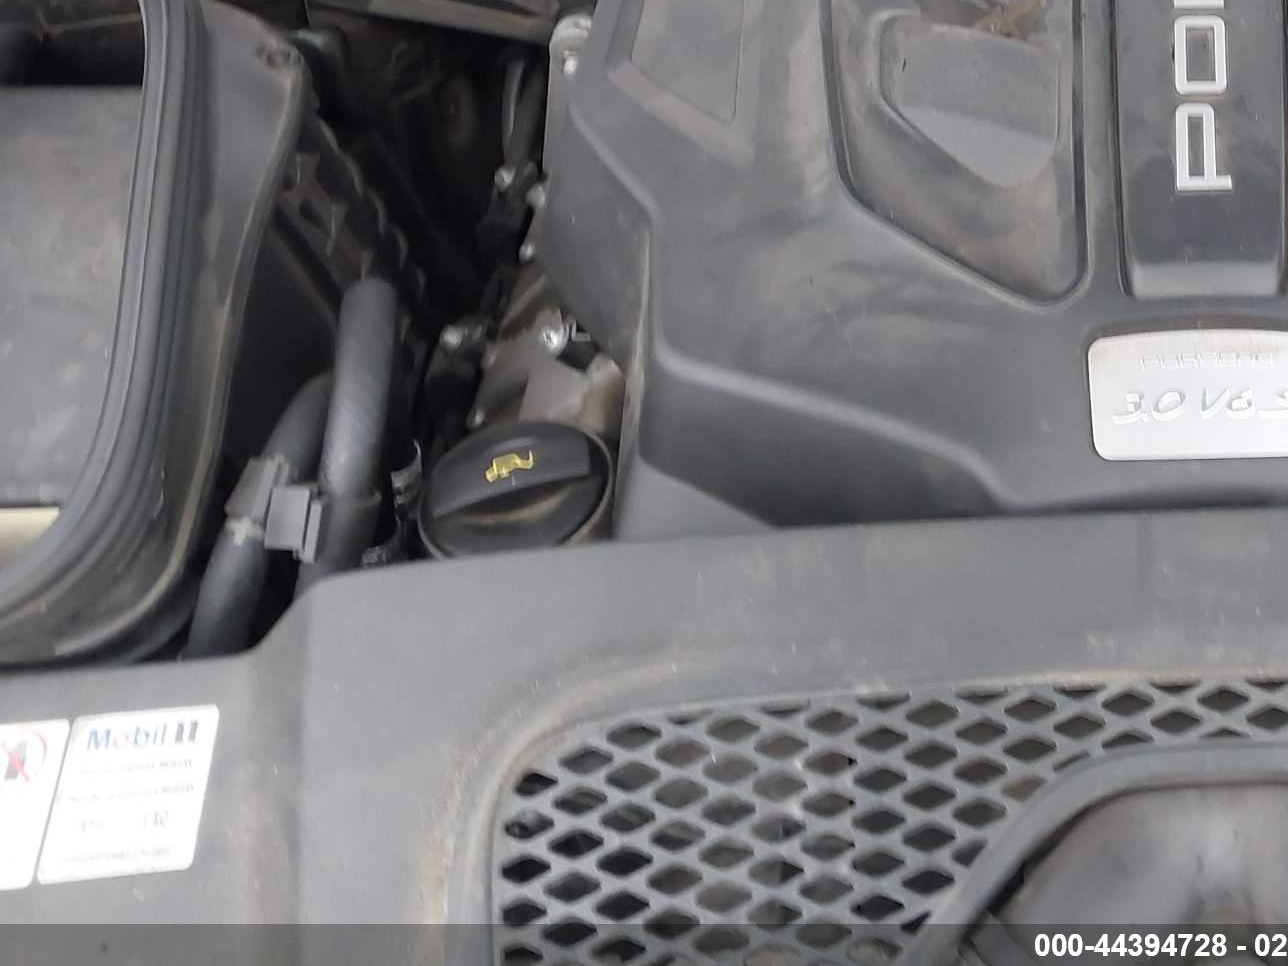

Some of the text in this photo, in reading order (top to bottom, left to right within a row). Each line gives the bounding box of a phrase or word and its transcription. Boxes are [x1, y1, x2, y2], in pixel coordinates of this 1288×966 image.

[1112, 387, 1186, 425] 3.0
[1200, 385, 1256, 421] V6
[86, 723, 168, 753] Mobil
